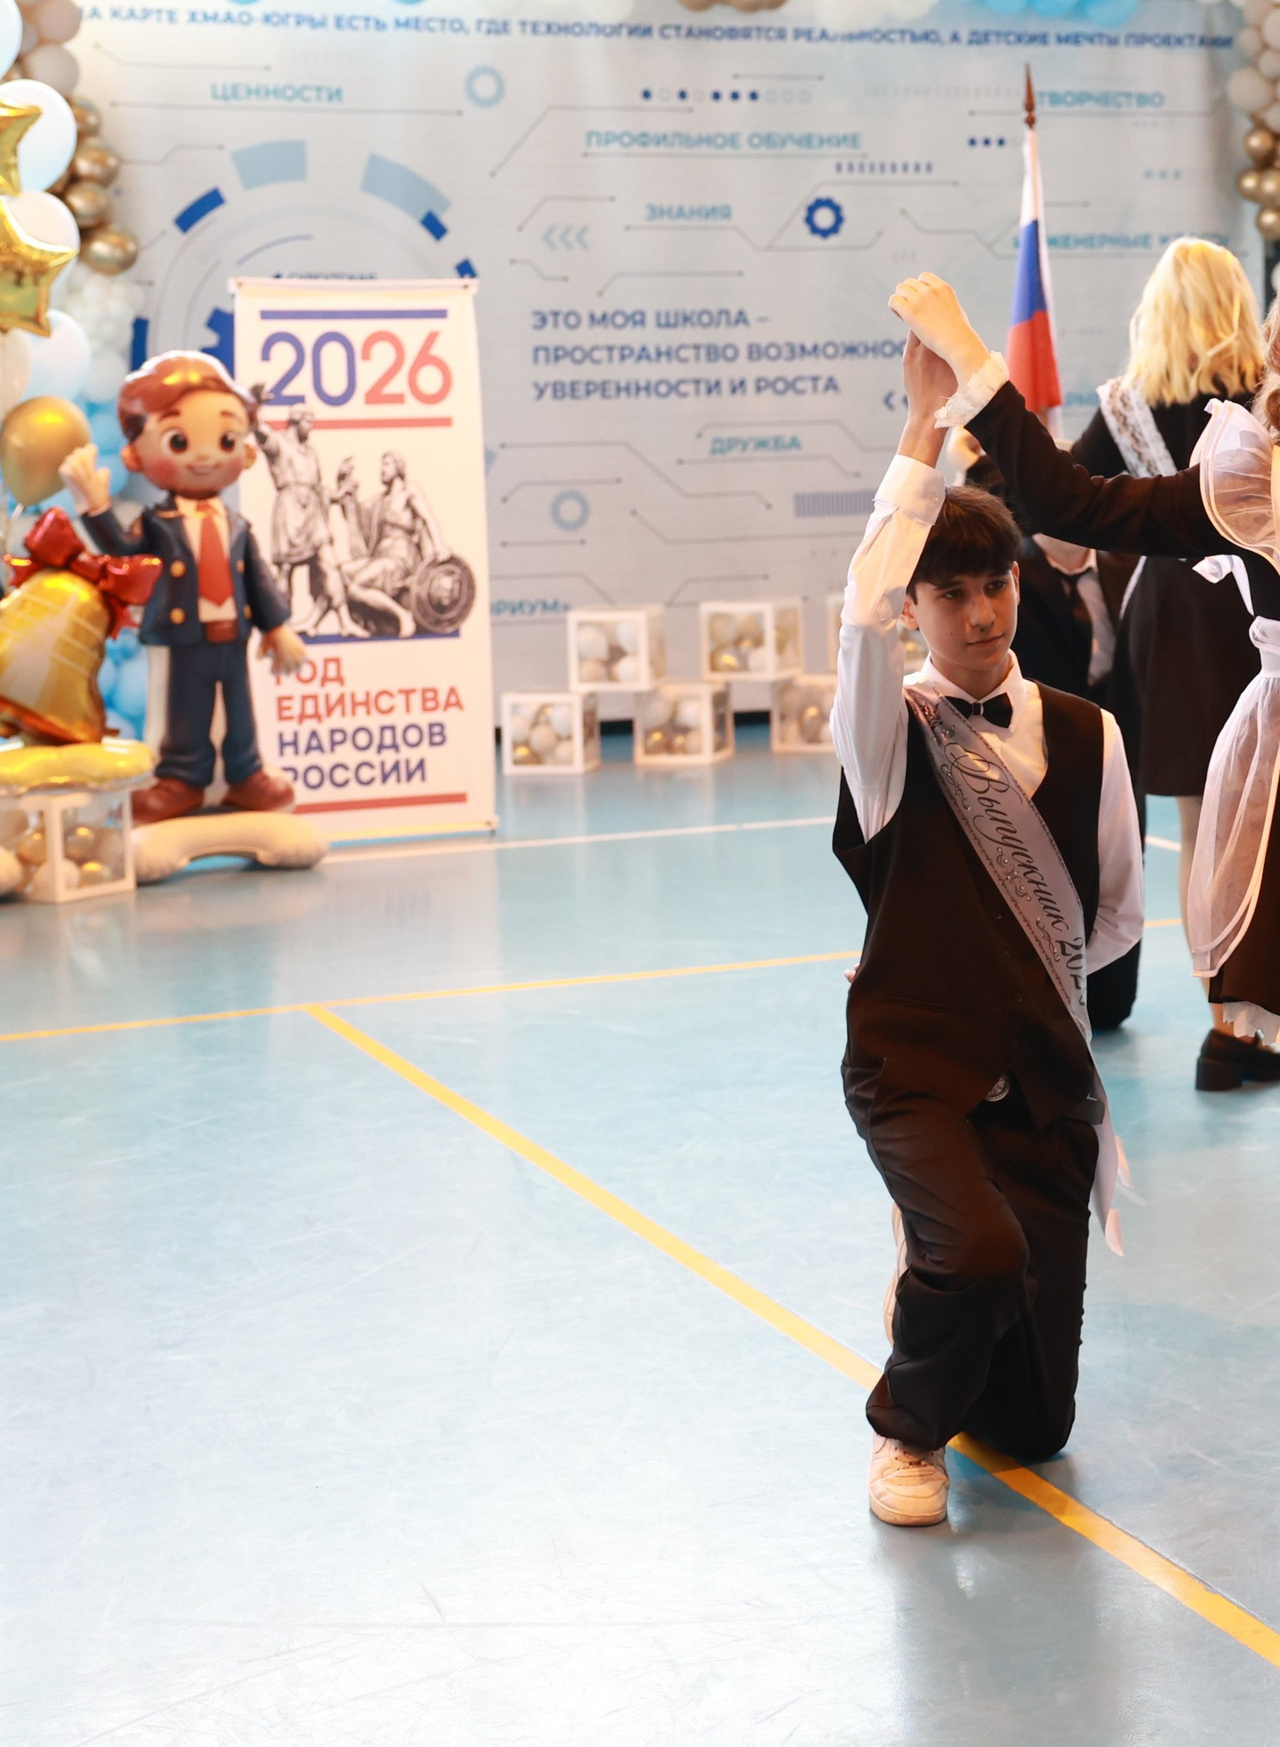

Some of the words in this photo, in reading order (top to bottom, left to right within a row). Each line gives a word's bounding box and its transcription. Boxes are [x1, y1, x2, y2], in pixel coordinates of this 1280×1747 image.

[110, 8, 178, 25] КАРТЕ
[187, 11, 328, 30] ХМАО-ЮГРЫ
[333, 15, 387, 32] ЕСТЬ
[394, 17, 470, 36] МЕСТО,
[476, 19, 511, 37] ГДЕ
[519, 21, 653, 39] ТЕХНОЛОГИИ
[659, 25, 787, 42] СТАНОВЯТСЯ
[950, 30, 962, 45] А
[967, 29, 1048, 47] ДЕТСКИЕ
[1056, 31, 1118, 47] МЕЧТЫ
[1125, 31, 1234, 49] ПРОЕКТАМИ
[211, 82, 343, 103] ЦЕННОСТИ
[1037, 90, 1165, 108] ТВОРЧЕСТВО
[586, 131, 742, 150] ПРОФИЛЬНОЕ
[748, 132, 861, 150] ОБУЧЕНИЕ
[645, 203, 732, 222] ЗНАНИЯ
[531, 309, 582, 331] ЭТО
[588, 309, 646, 331] МОЯ
[655, 308, 750, 330] ШКОЛА
[532, 341, 740, 366] ПРОСТРАНСТВО
[260, 331, 453, 407] 2026
[533, 377, 722, 401] УВЕРЕННОСТИ
[729, 377, 747, 397] И
[754, 374, 841, 396] РОСТА
[709, 434, 802, 456] ДРУЖБА
[274, 656, 345, 688] ОД
[276, 685, 464, 725] ЕДИНСТВА
[278, 722, 447, 757] НАРОДОВ
[943, 741, 1069, 933] Выпускник
